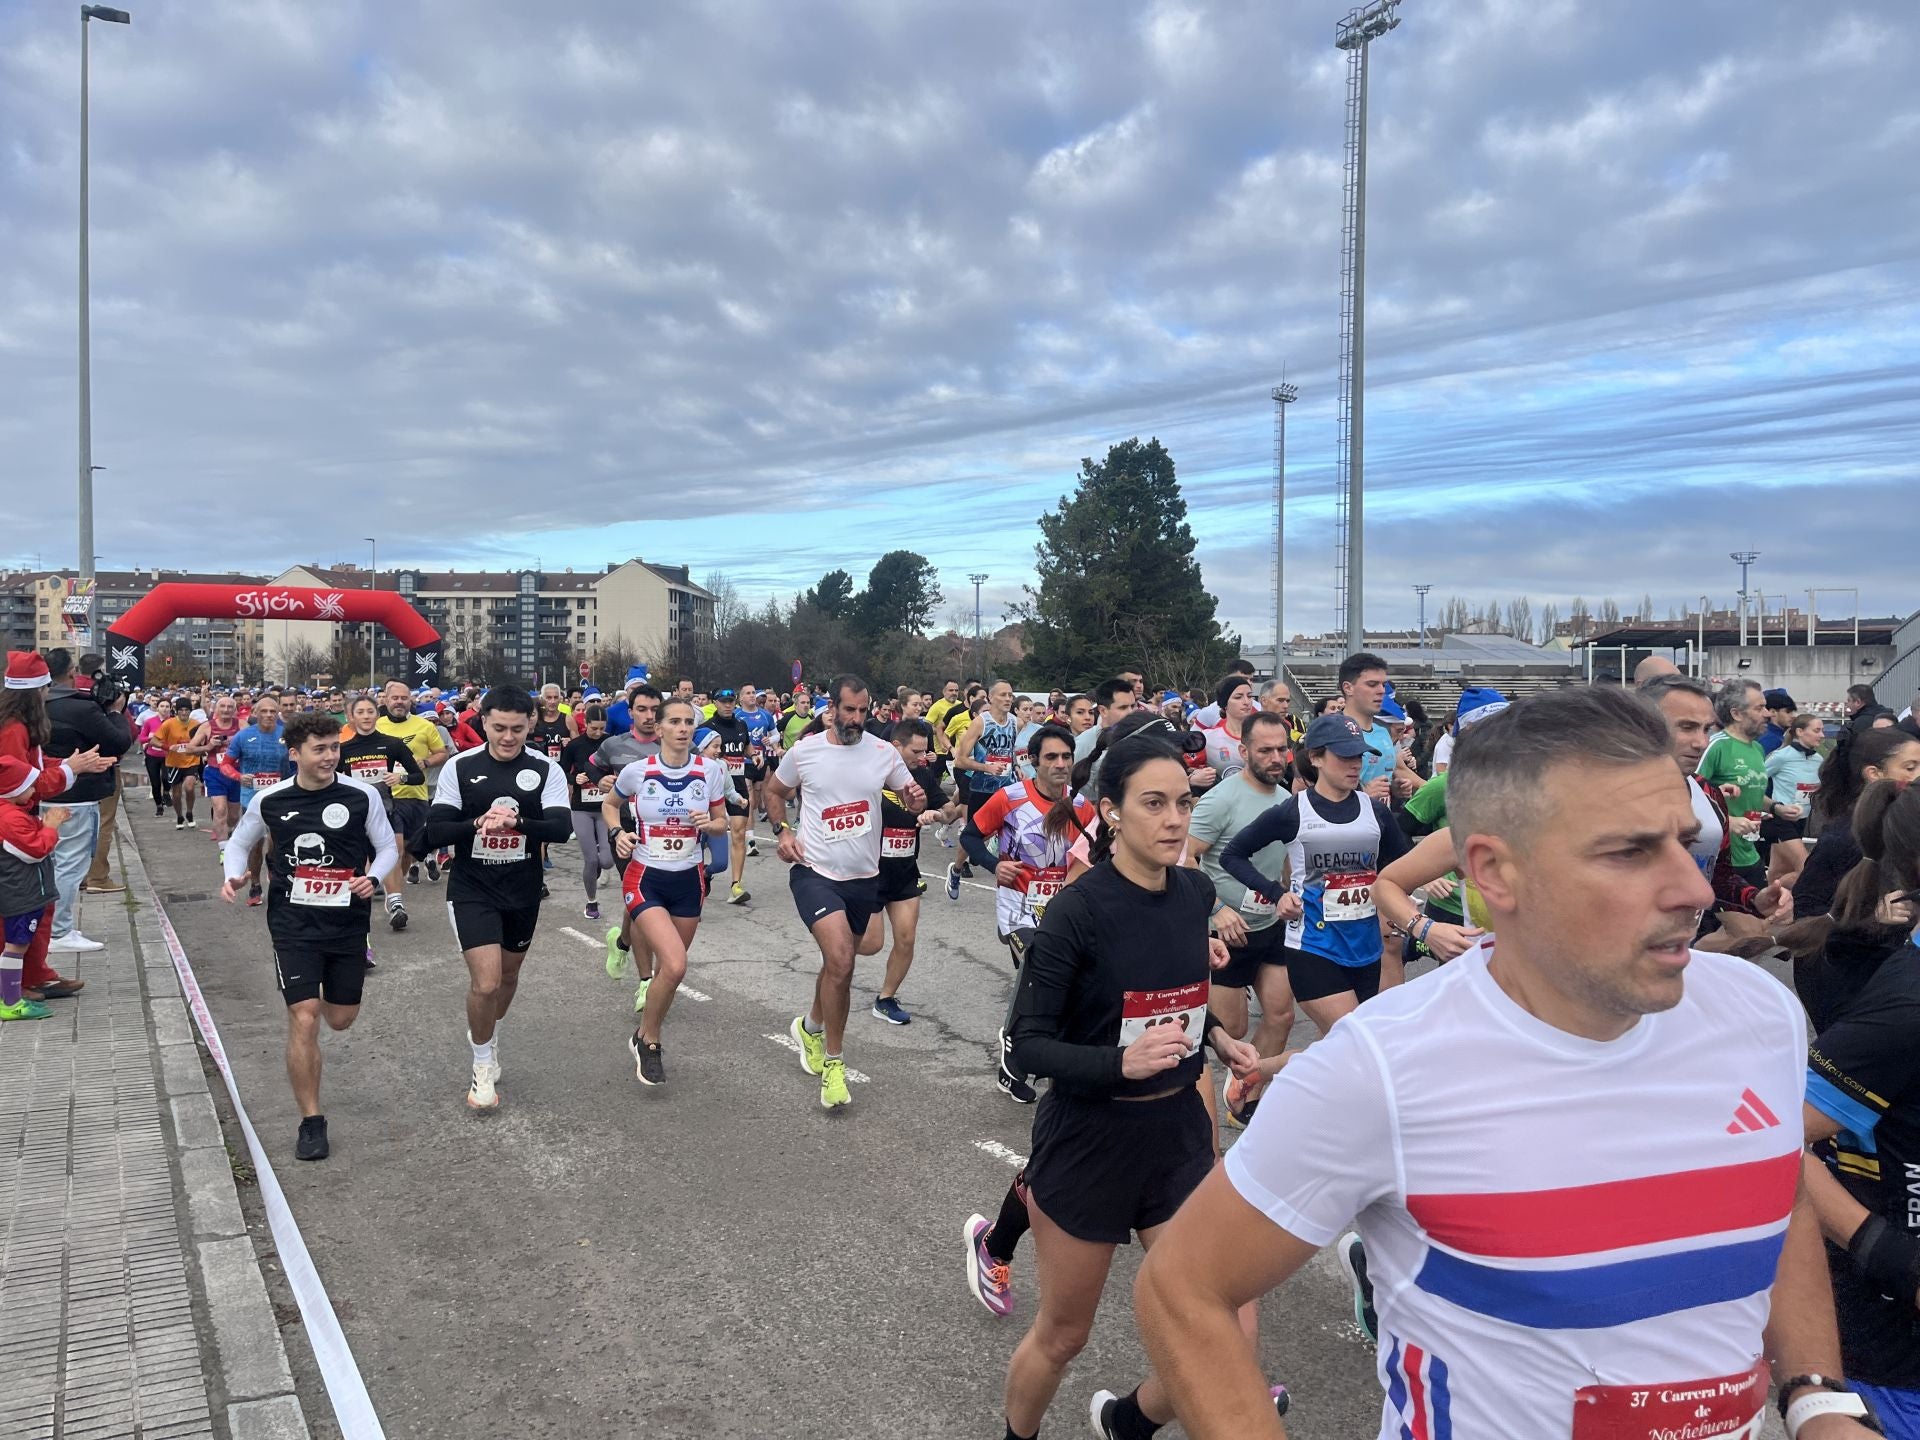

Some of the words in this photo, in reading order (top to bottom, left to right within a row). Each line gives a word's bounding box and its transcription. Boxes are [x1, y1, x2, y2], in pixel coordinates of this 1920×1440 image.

[235, 592, 305, 616] gijón
[360, 769, 379, 777] 129
[827, 814, 865, 832] 1650
[481, 837, 520, 849] 1888
[663, 839, 684, 851] 30
[888, 838, 914, 849] 1859
[304, 881, 343, 894] 1917
[1337, 888, 1370, 907] 449
[1145, 993, 1154, 1001] 37
[1630, 1391, 1649, 1407] 37
[1694, 1404, 1711, 1418] de
[1648, 1416, 1740, 1440] Nochebuena
